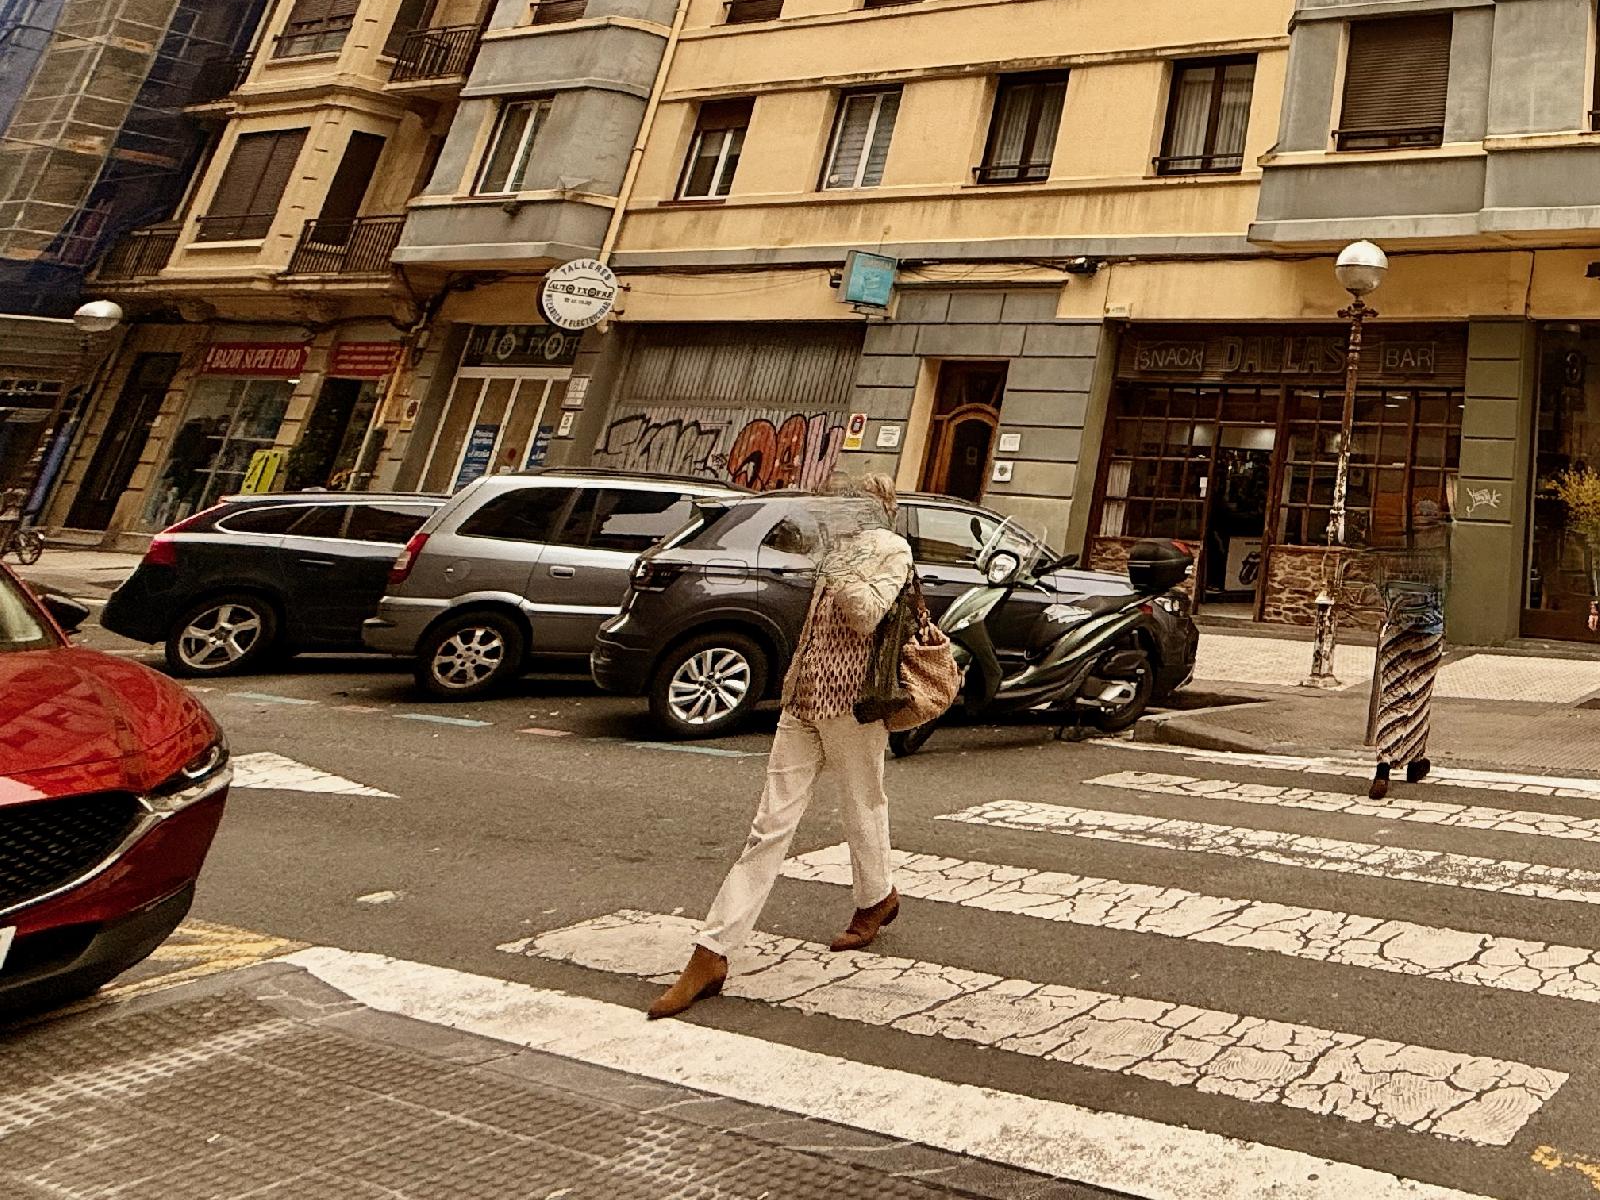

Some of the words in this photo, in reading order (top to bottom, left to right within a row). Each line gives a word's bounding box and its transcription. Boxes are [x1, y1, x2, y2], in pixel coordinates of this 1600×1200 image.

[560, 261, 612, 281] TALLERES
[1140, 346, 1201, 369] SNACK
[1222, 335, 1347, 373] DALLAS
[1385, 347, 1431, 368] BAR
